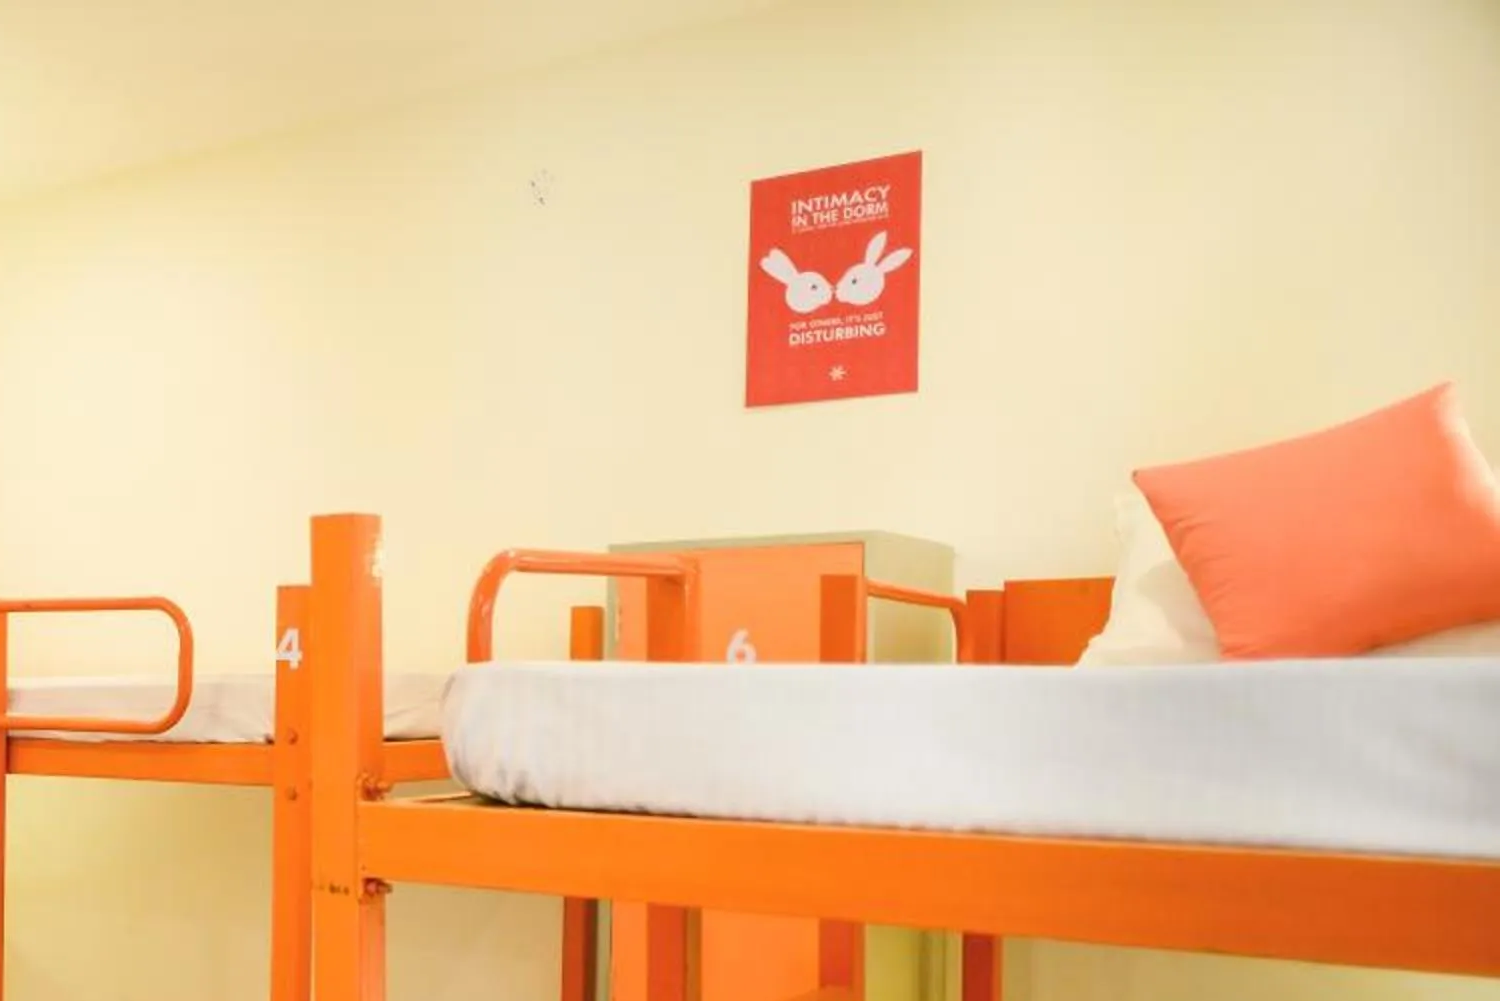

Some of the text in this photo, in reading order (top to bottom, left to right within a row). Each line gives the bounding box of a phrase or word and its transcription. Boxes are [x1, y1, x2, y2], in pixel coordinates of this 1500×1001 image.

[791, 184, 891, 215] INTIMACY
[791, 215, 808, 228] IN
[813, 210, 839, 225] THE
[844, 202, 889, 219] DORM
[789, 322, 885, 345] DISTURBING
[276, 628, 303, 671] 4
[726, 629, 757, 665] 6
